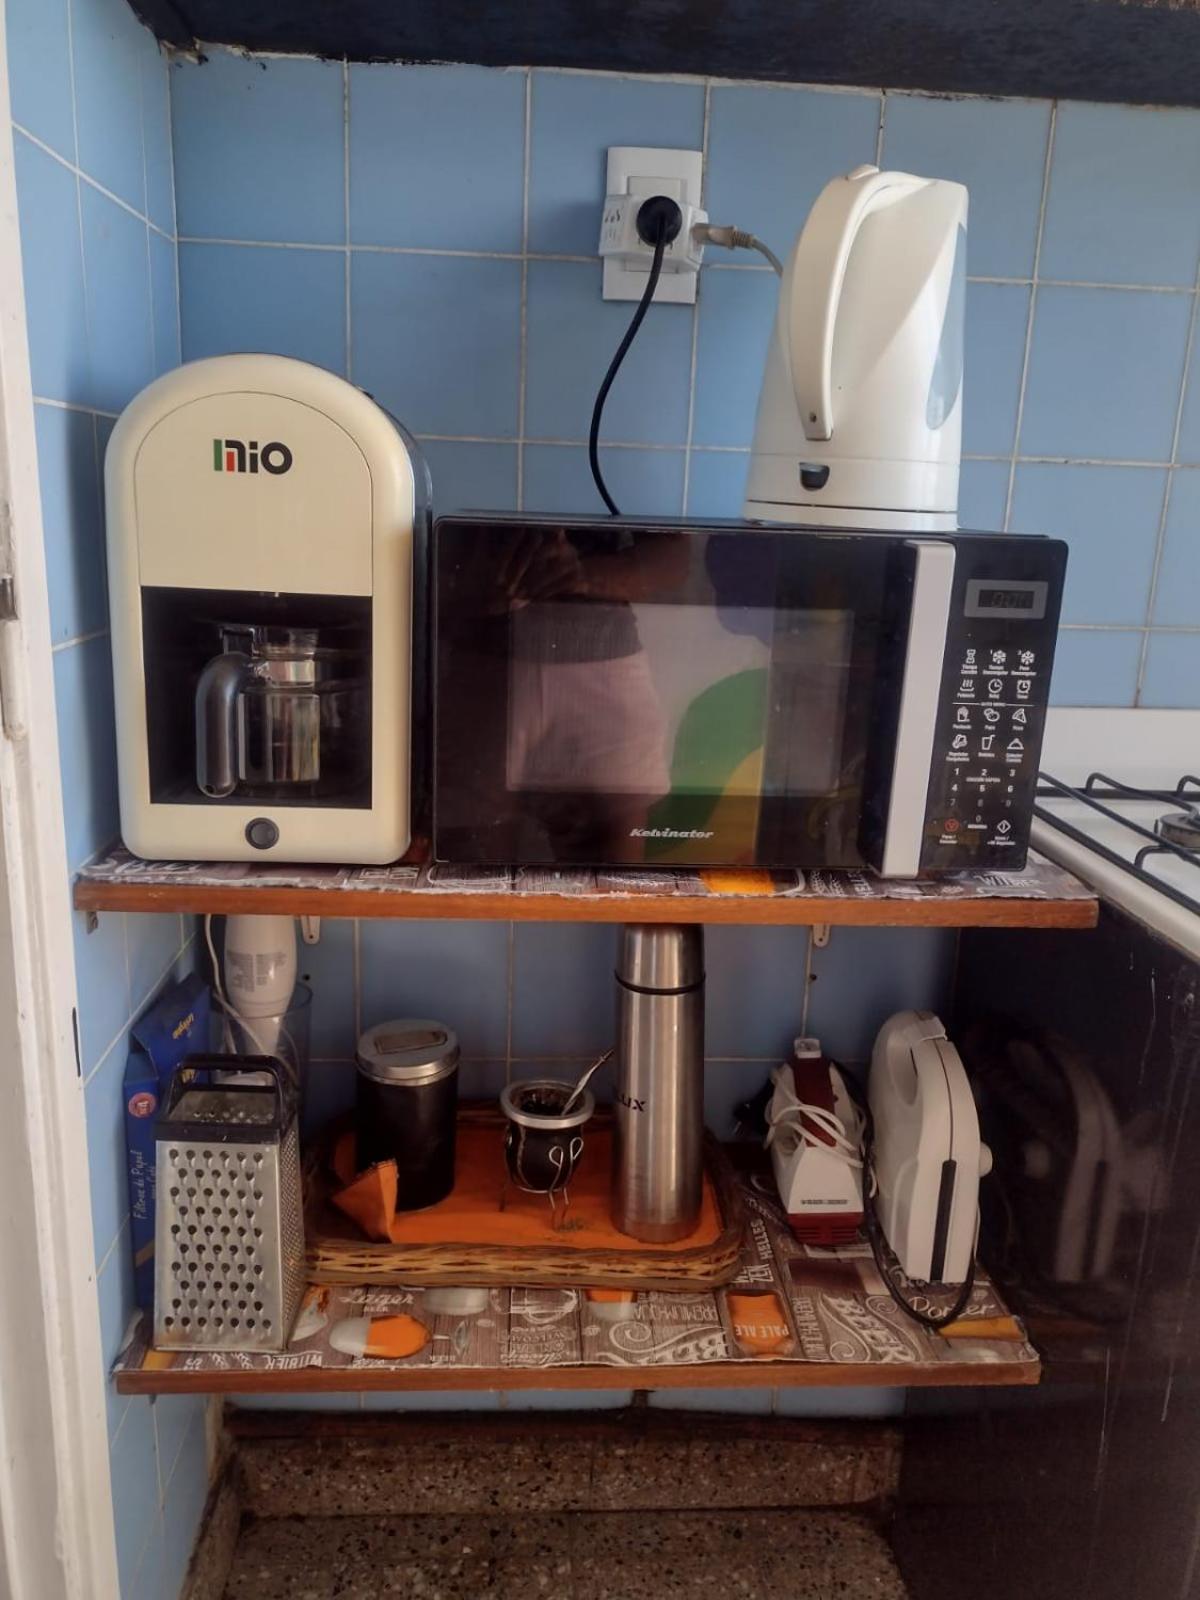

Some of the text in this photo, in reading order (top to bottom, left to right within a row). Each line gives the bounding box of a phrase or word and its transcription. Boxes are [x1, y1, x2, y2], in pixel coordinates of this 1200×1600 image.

[629, 828, 714, 838] Kelvinator
[735, 1324, 789, 1338] PALE ALE
